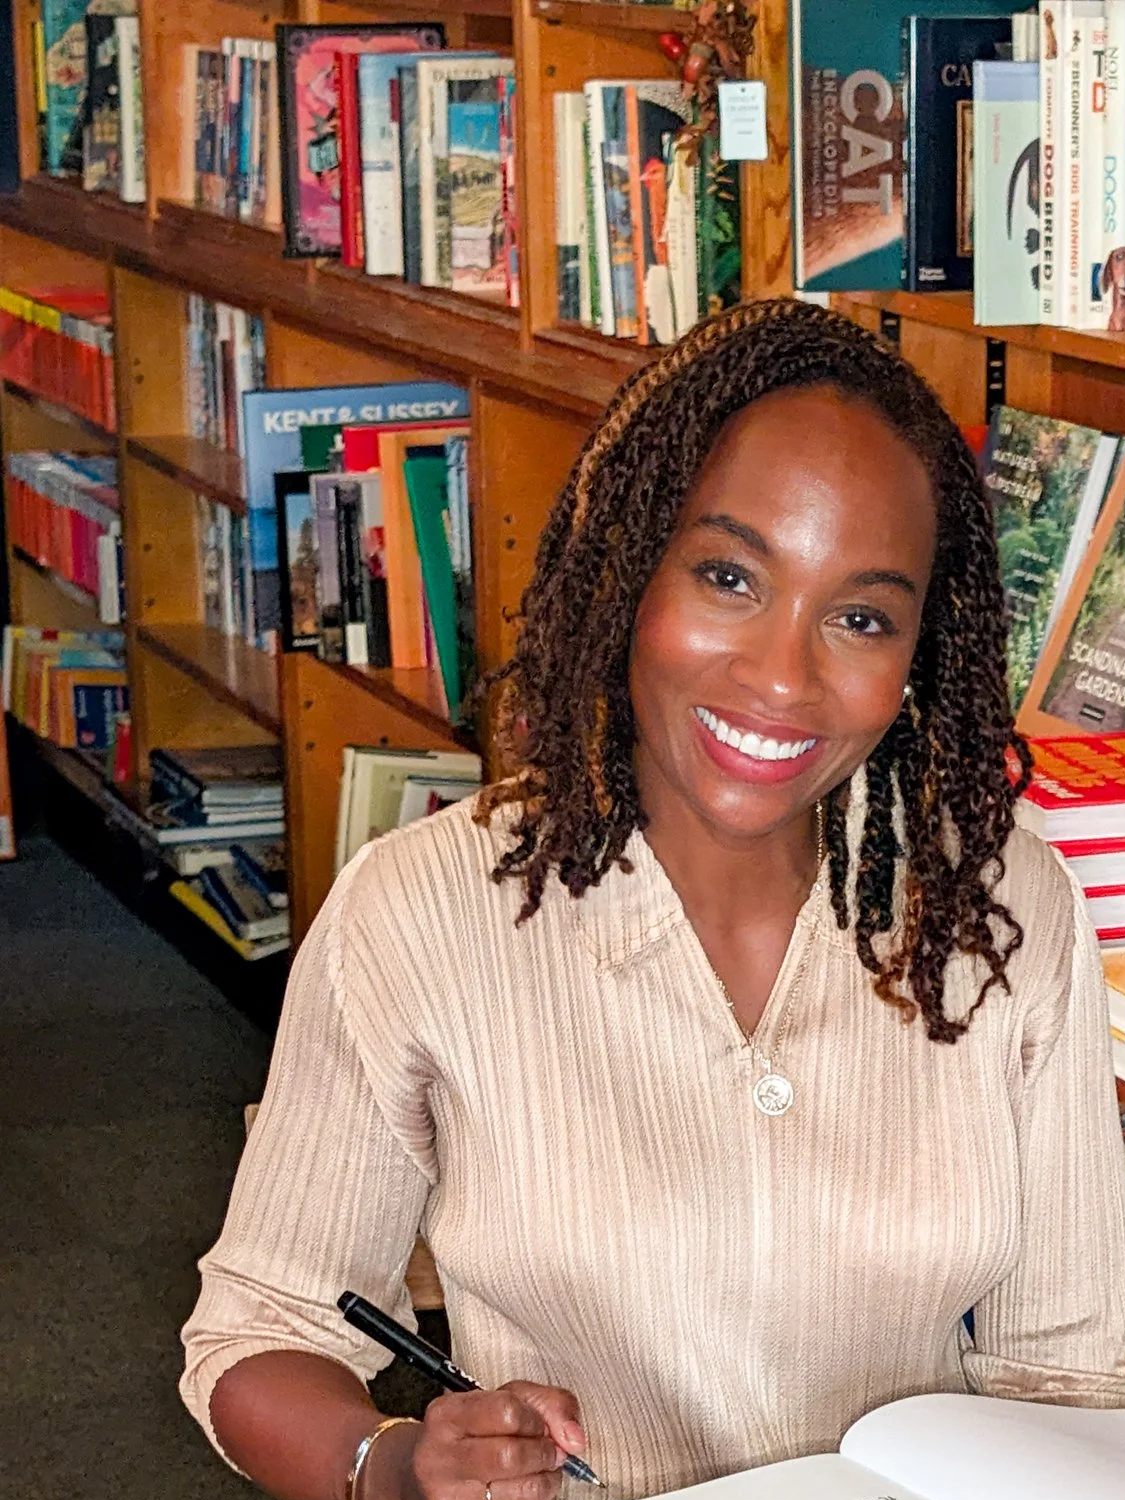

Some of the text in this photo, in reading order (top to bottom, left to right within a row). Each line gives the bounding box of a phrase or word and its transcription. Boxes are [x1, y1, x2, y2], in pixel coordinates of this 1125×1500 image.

[840, 69, 894, 216] CAT
[1044, 145, 1055, 198] DOG
[1104, 155, 1118, 234] DOGS
[264, 407, 337, 434] KENT
